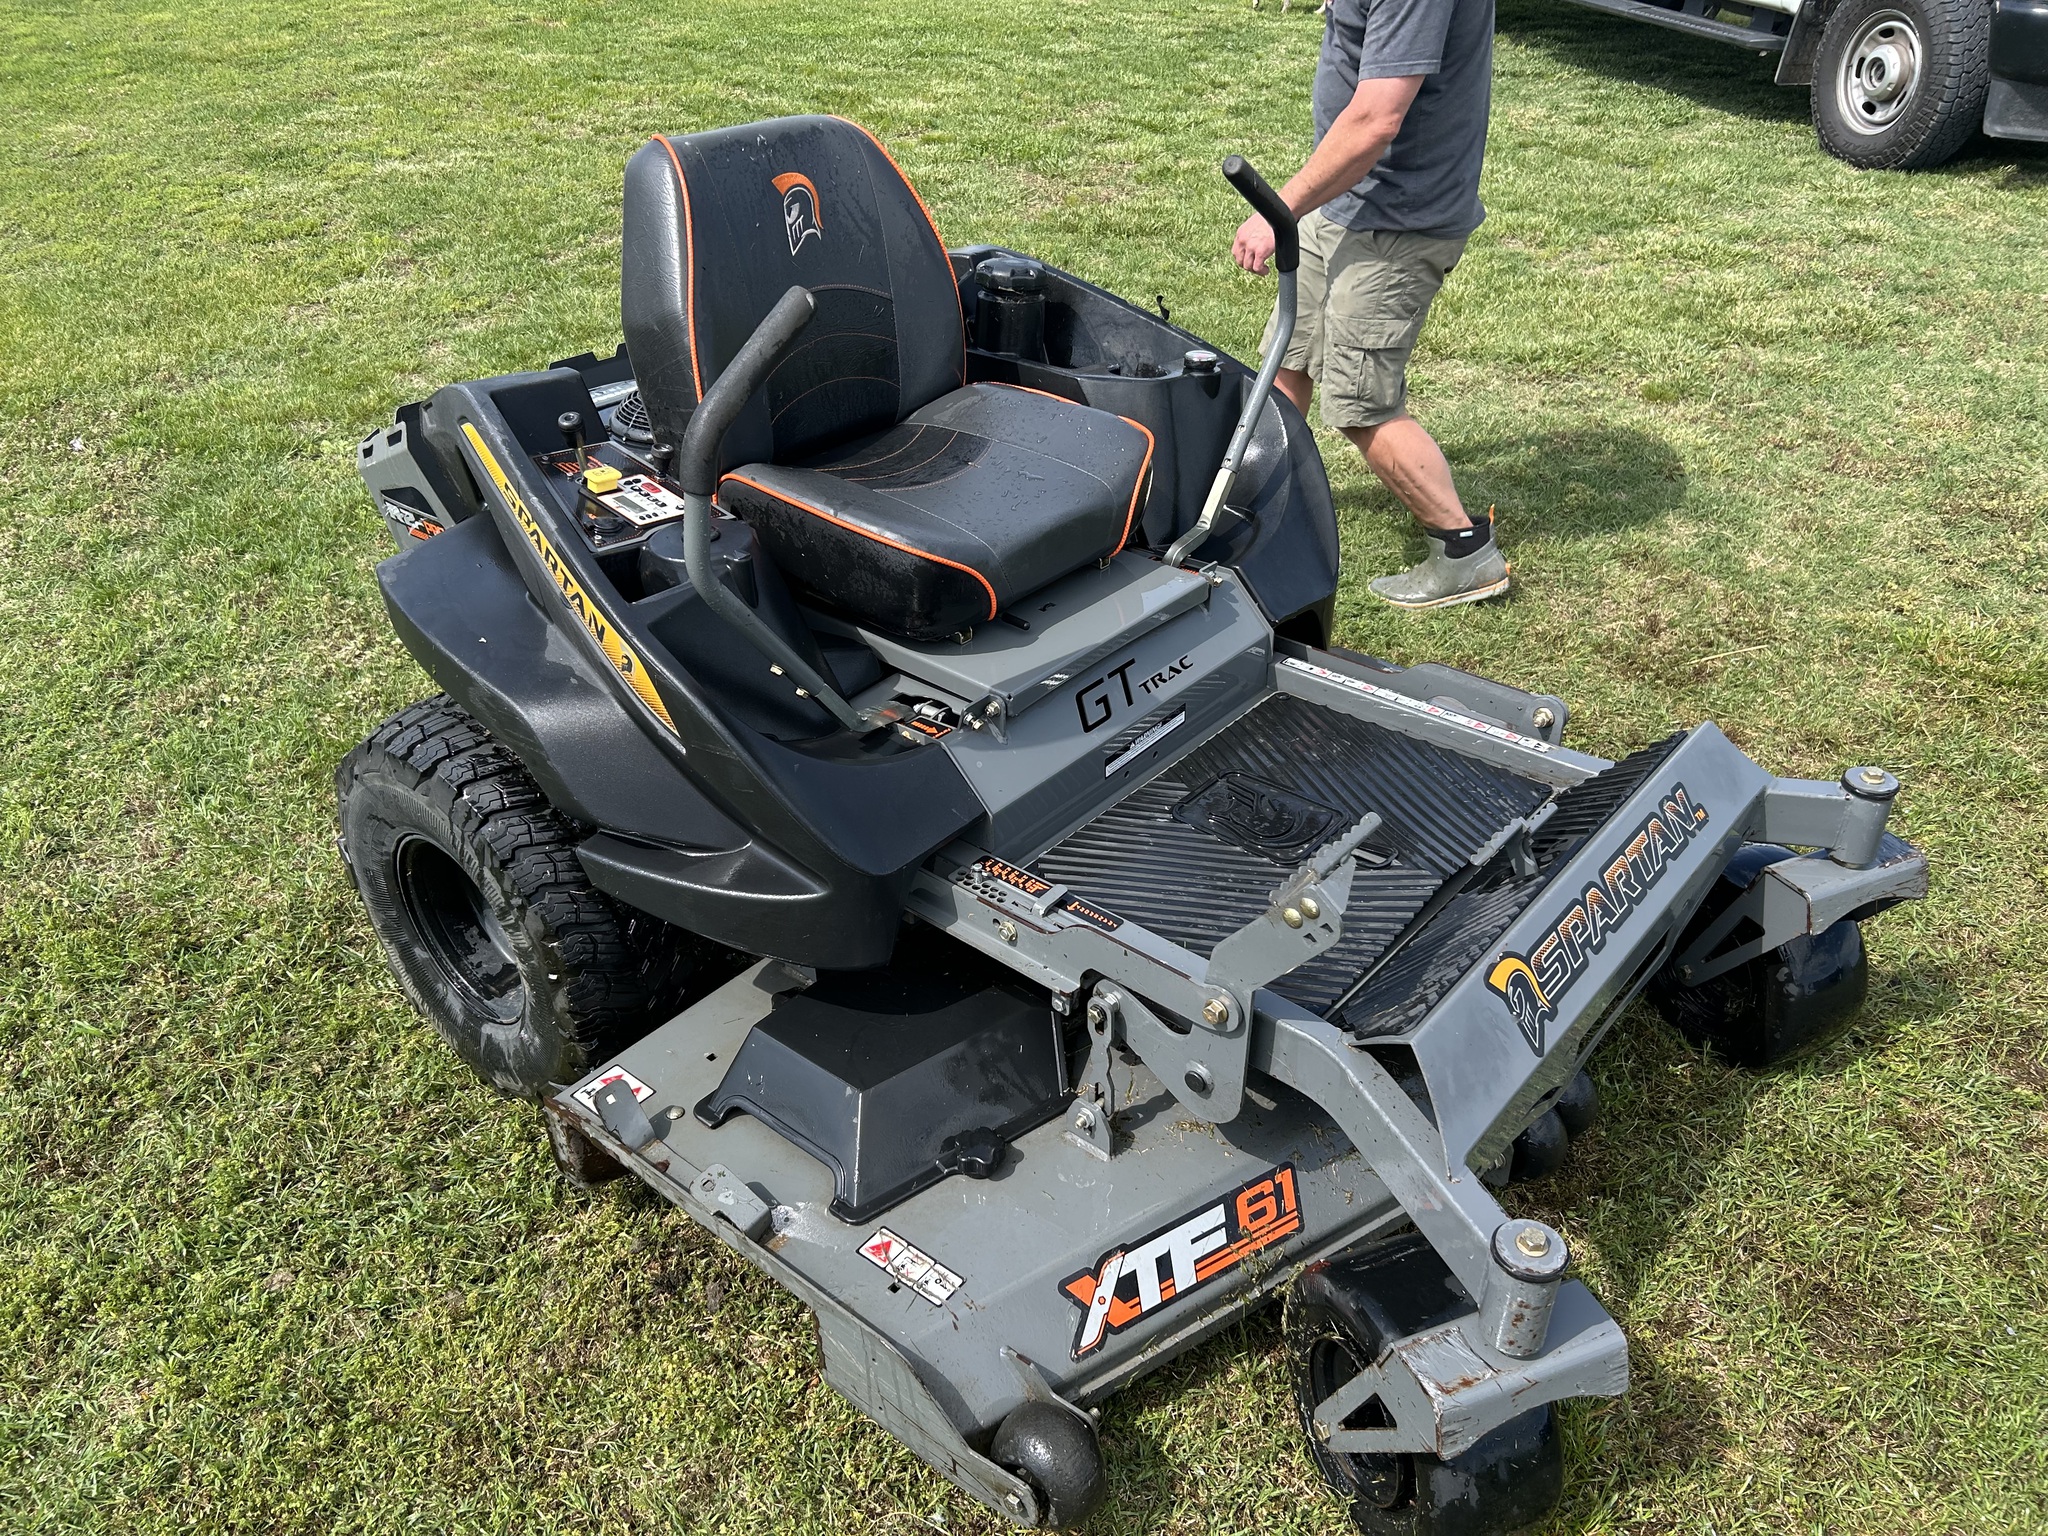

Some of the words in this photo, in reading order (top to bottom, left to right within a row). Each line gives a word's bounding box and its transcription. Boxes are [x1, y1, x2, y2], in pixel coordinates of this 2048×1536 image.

[502, 481, 607, 645] SPARTAN
[1075, 657, 1136, 734] GT
[1138, 654, 1194, 694] TRAC
[1530, 788, 1698, 1001] SPARTAN
[1064, 1202, 1228, 1356] XTF
[1235, 1167, 1298, 1232] 61
